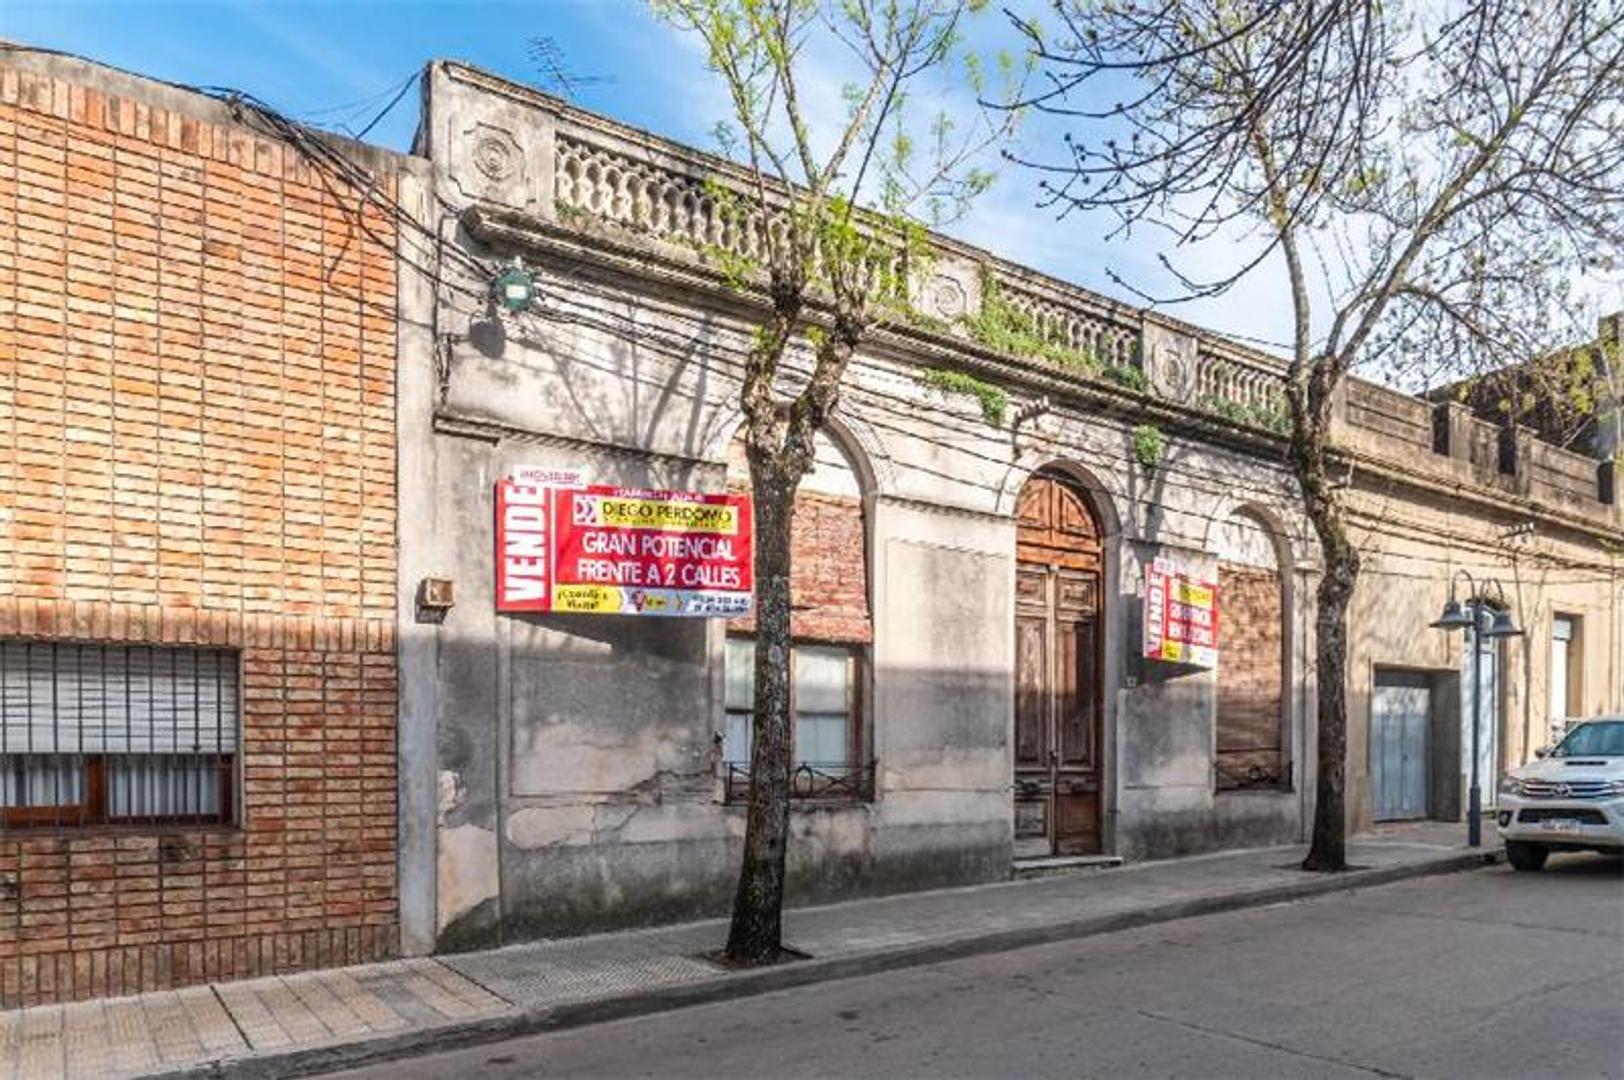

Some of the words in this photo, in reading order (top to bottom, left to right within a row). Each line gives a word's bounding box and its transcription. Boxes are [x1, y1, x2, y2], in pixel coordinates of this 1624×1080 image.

[602, 501, 653, 518] DIEGO
[656, 504, 733, 523] PERDOMO
[504, 485, 545, 602] VENDE
[582, 531, 637, 556] GRAN
[641, 535, 737, 560] POTENCIAL
[577, 558, 642, 583] FRENTE
[646, 562, 661, 583] A
[665, 562, 676, 585] 2
[681, 563, 741, 588] CALLES
